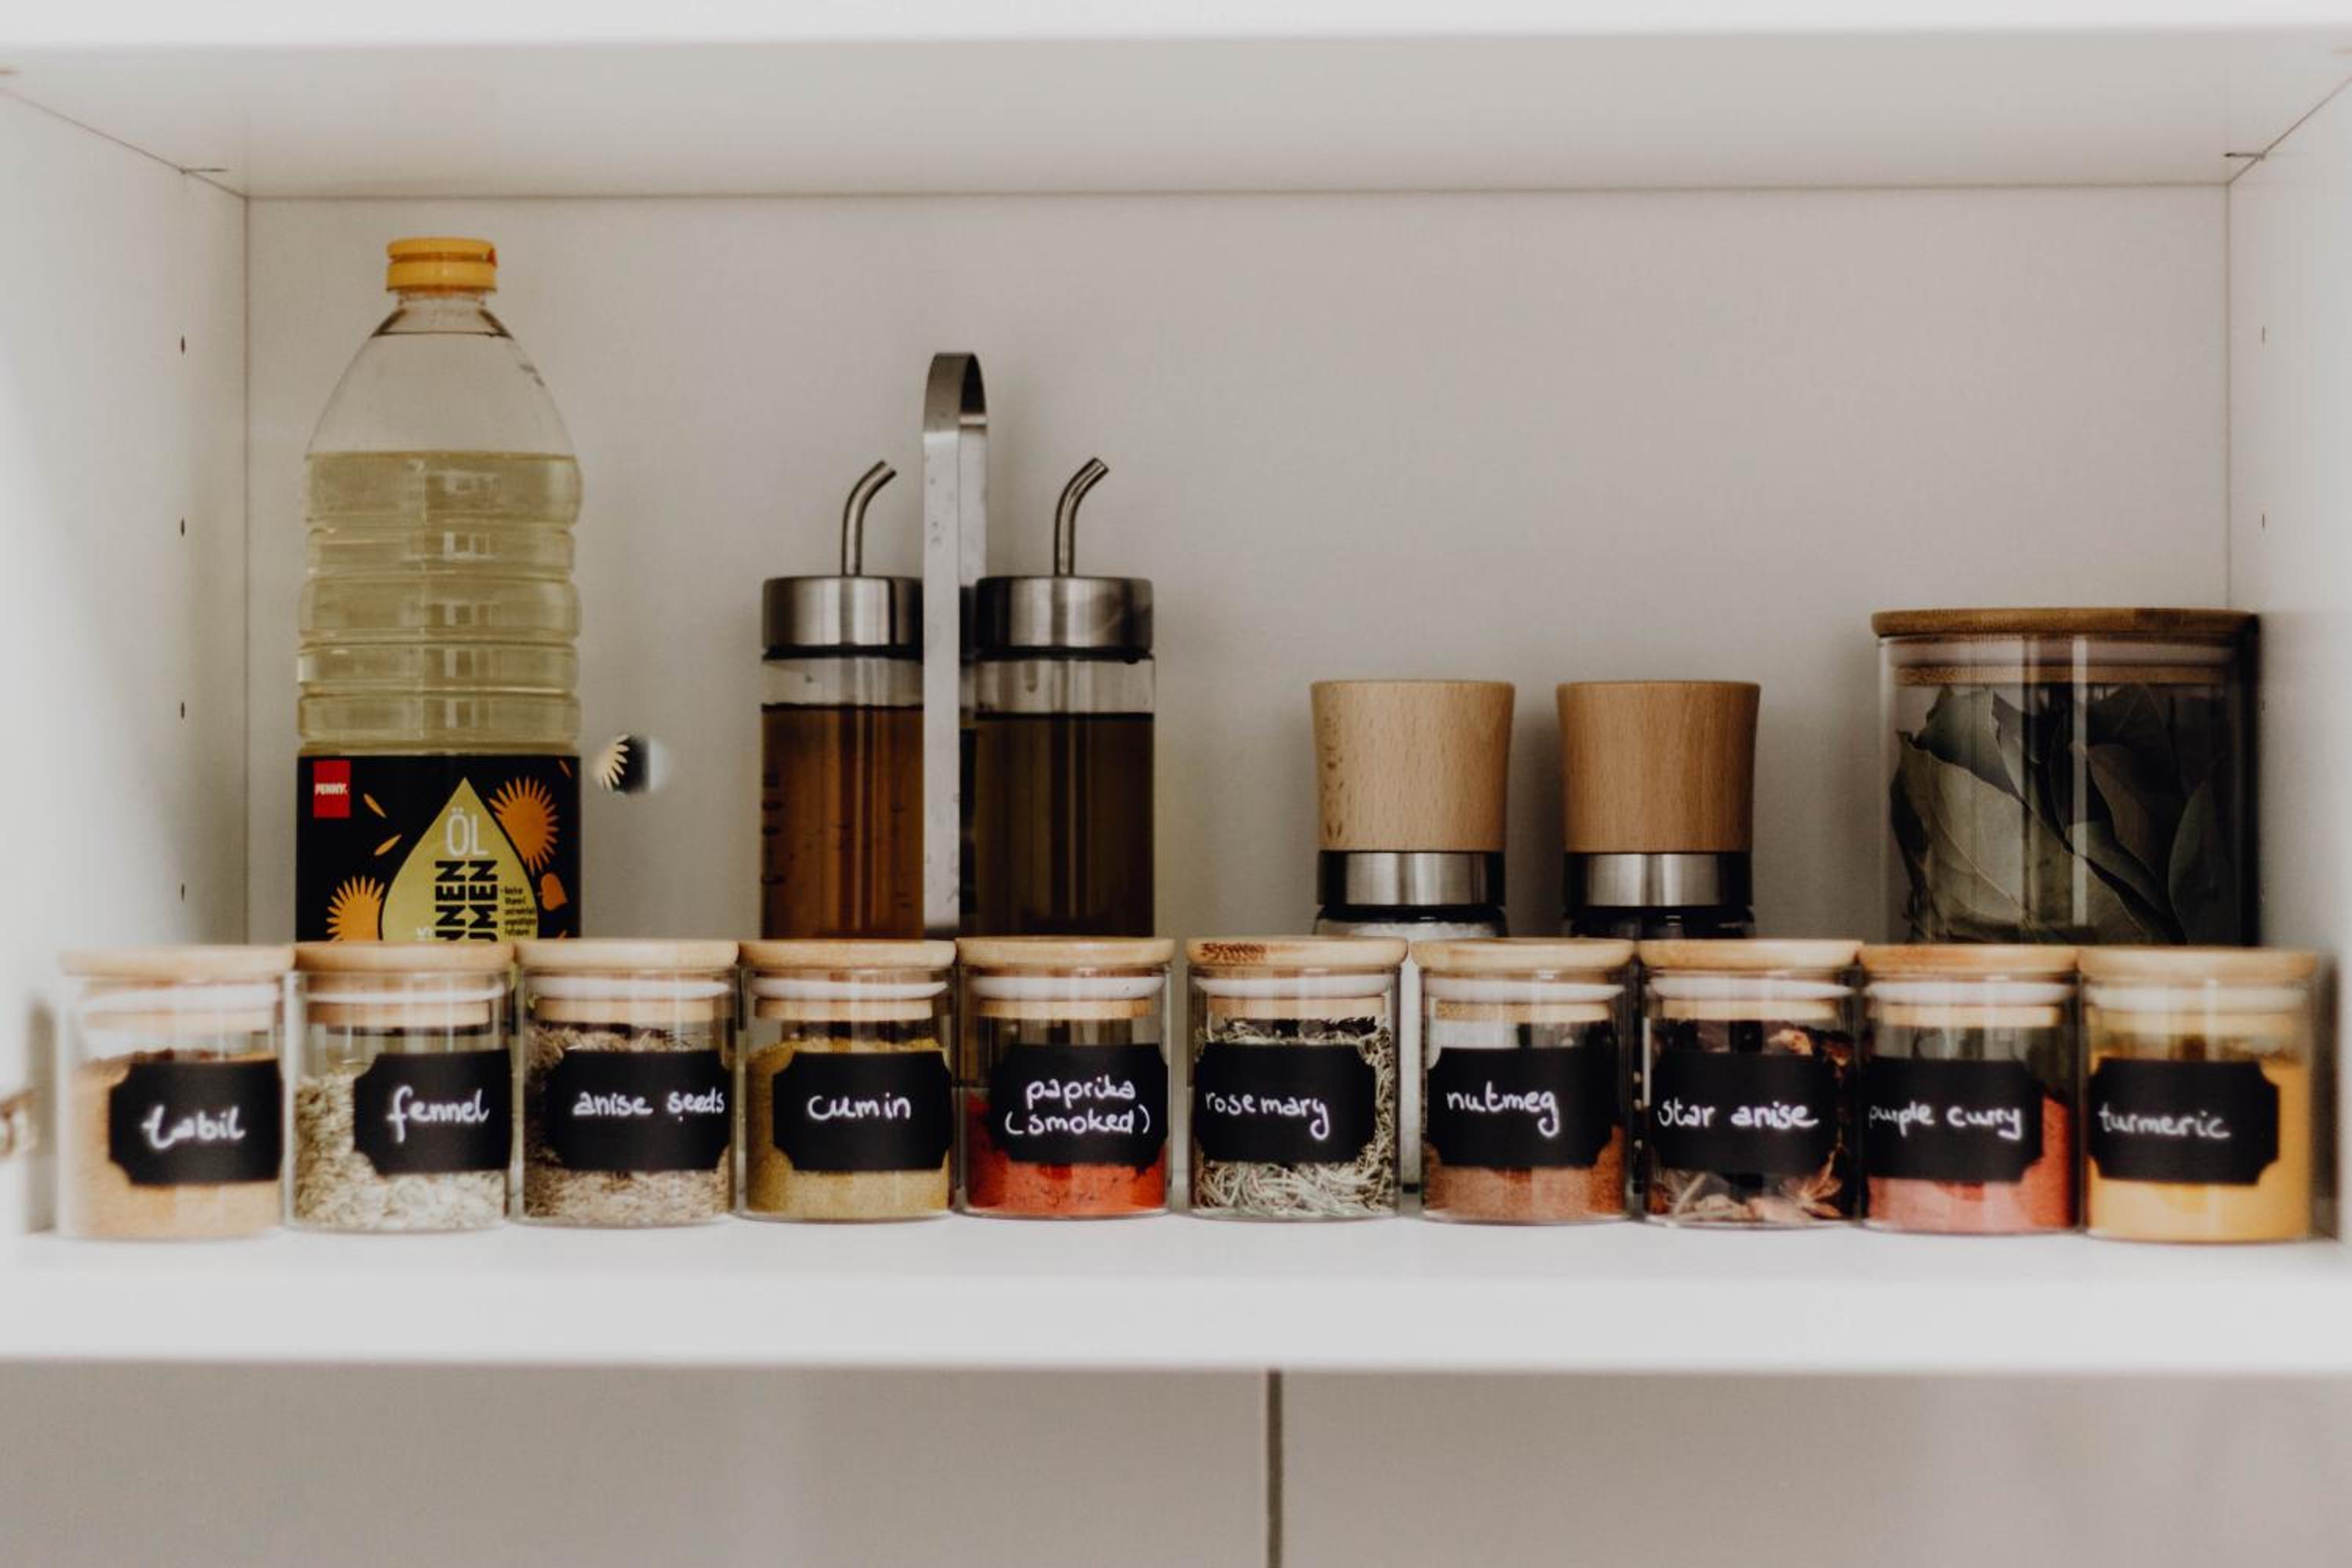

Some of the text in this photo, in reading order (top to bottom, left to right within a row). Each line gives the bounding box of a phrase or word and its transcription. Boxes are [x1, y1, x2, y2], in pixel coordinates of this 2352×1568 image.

[446, 807, 489, 857] ÖL
[572, 1087, 725, 1118] anise seeds
[807, 1092, 911, 1121] cumin
[1026, 1074, 1136, 1110] paprika
[1446, 1081, 1560, 1138] nutmeg
[141, 1104, 246, 1150] tabil
[387, 1085, 490, 1143] fennel
[1004, 1103, 1150, 1135] (smoked)
[1205, 1092, 1330, 1142] rosemary
[1657, 1098, 1819, 1131] star anise
[1947, 1106, 2023, 1142] curry
[2099, 1103, 2230, 1139] turmeric
